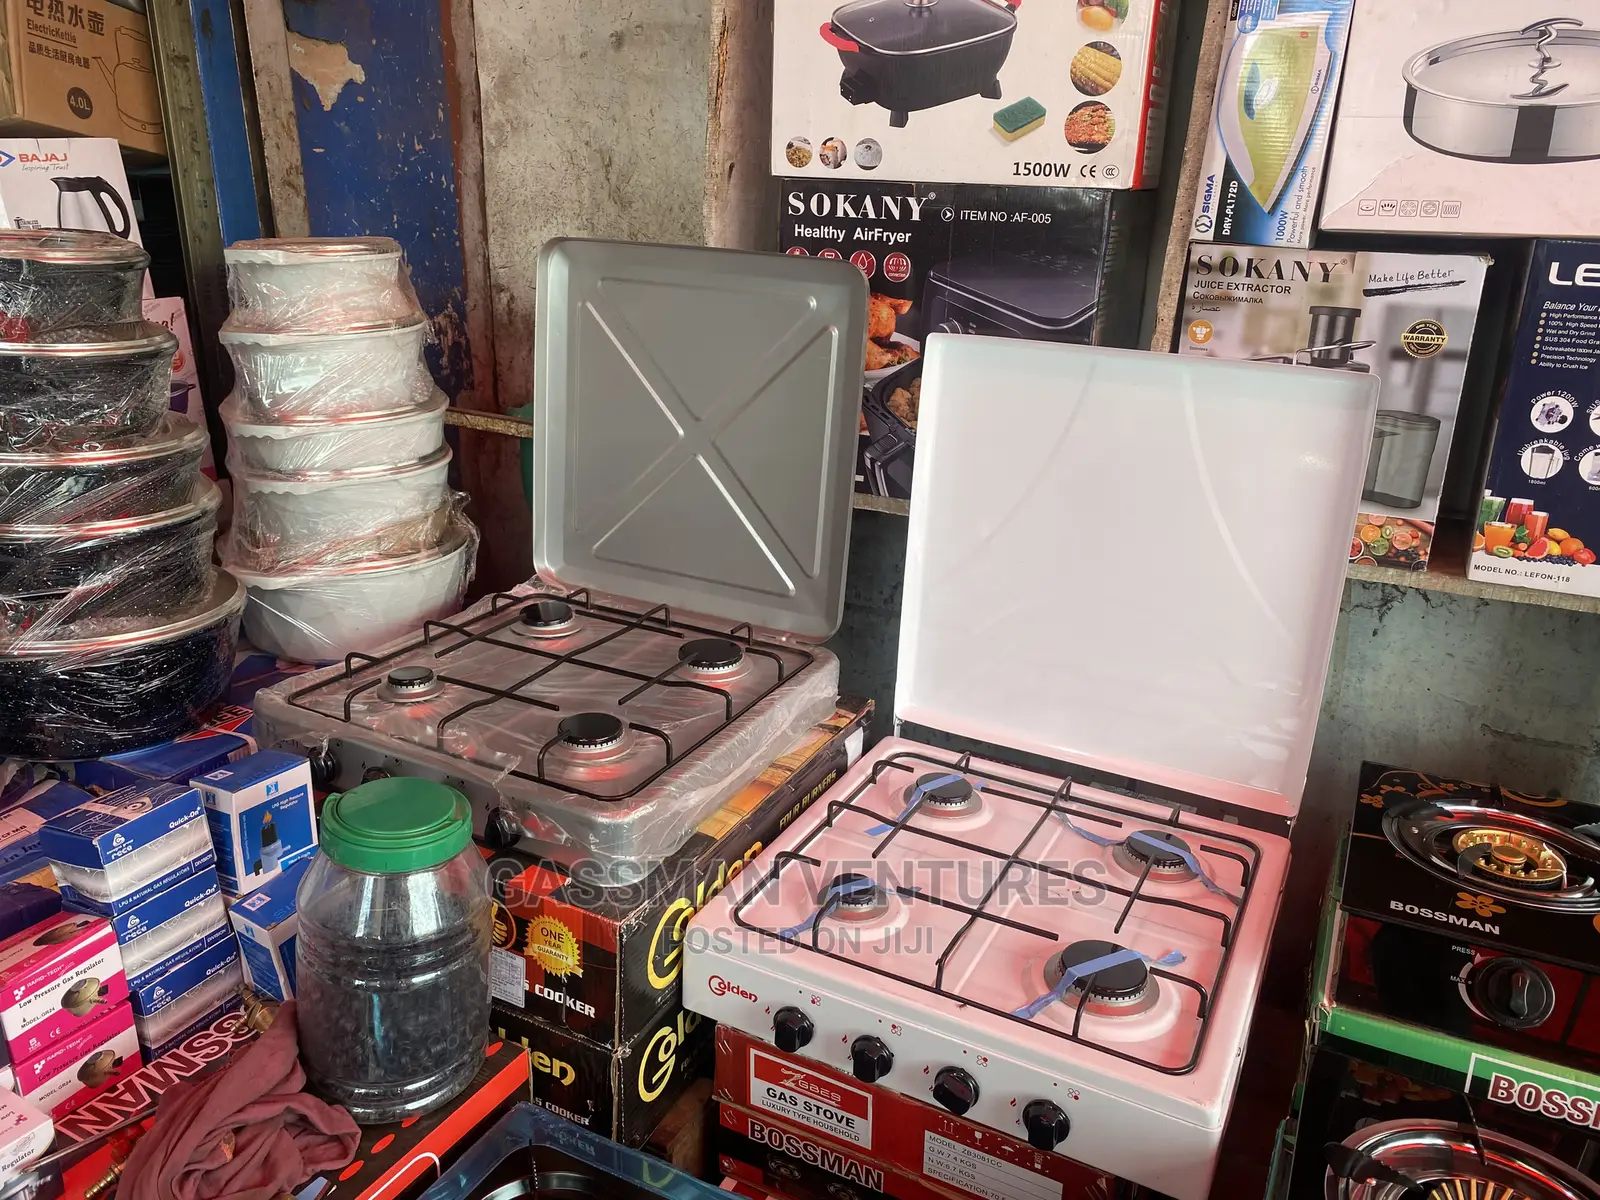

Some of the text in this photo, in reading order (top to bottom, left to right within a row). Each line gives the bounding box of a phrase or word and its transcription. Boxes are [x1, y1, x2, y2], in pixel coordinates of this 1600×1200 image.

[26, 0, 105, 36] 电热水壶
[26, 18, 77, 44] ElectricKettle
[69, 95, 91, 111] 4.0L
[18, 152, 68, 163] BAJAJ
[1012, 162, 1071, 178] 1500W
[1201, 174, 1216, 214] SIGMA
[1286, 165, 1308, 243] Powerful and smooth
[960, 210, 987, 222] ITEM
[989, 211, 1008, 223] NO
[1222, 180, 1239, 236] DRY-PL172D
[794, 223, 912, 246] Healthy AirFryer
[1275, 210, 1289, 241] 1000W
[1368, 268, 1455, 284] Make Life Better
[1194, 280, 1291, 295] JUICE EXTRACTOR
[1543, 300, 1598, 312] Balance Your
[1403, 334, 1446, 343] WARRANTY
[1530, 389, 1579, 409] Power 1200W
[1516, 437, 1565, 457] Unbreakable
[1573, 446, 1594, 462] Come
[1473, 563, 1503, 574] MODEL
[1524, 570, 1571, 583] LEFON-118
[194, 853, 213, 867] DIVISION
[1389, 900, 1500, 935] BOSSMAN
[207, 928, 226, 943] DIVISION
[540, 927, 565, 944] ONE
[543, 938, 562, 950] YEAR
[537, 945, 569, 962] GUARANTY
[1451, 945, 1476, 956] PRESS
[18, 999, 32, 1009] Low
[33, 982, 61, 1001] Pressure
[62, 974, 74, 985] Gas
[75, 957, 104, 978] Regulator
[708, 975, 758, 1003] Golden
[1450, 975, 1466, 983] MAX
[534, 983, 596, 1019] COOKER
[38, 1071, 51, 1081] Low
[52, 1055, 79, 1074] Pressure
[80, 1047, 92, 1058] Gas
[92, 1031, 121, 1050] Regulator
[545, 1101, 590, 1126] COOKER
[766, 1087, 855, 1130] GAS STOVE
[761, 1099, 860, 1142] LUXURY TYPE HOUSEHOLD
[1, 1148, 35, 1172] Regulator
[748, 1118, 884, 1193] BOSSMAN
[959, 1158, 977, 1170] KGS
[961, 1147, 1003, 1168] ZB3081CC
[958, 1168, 976, 1180] KGS
